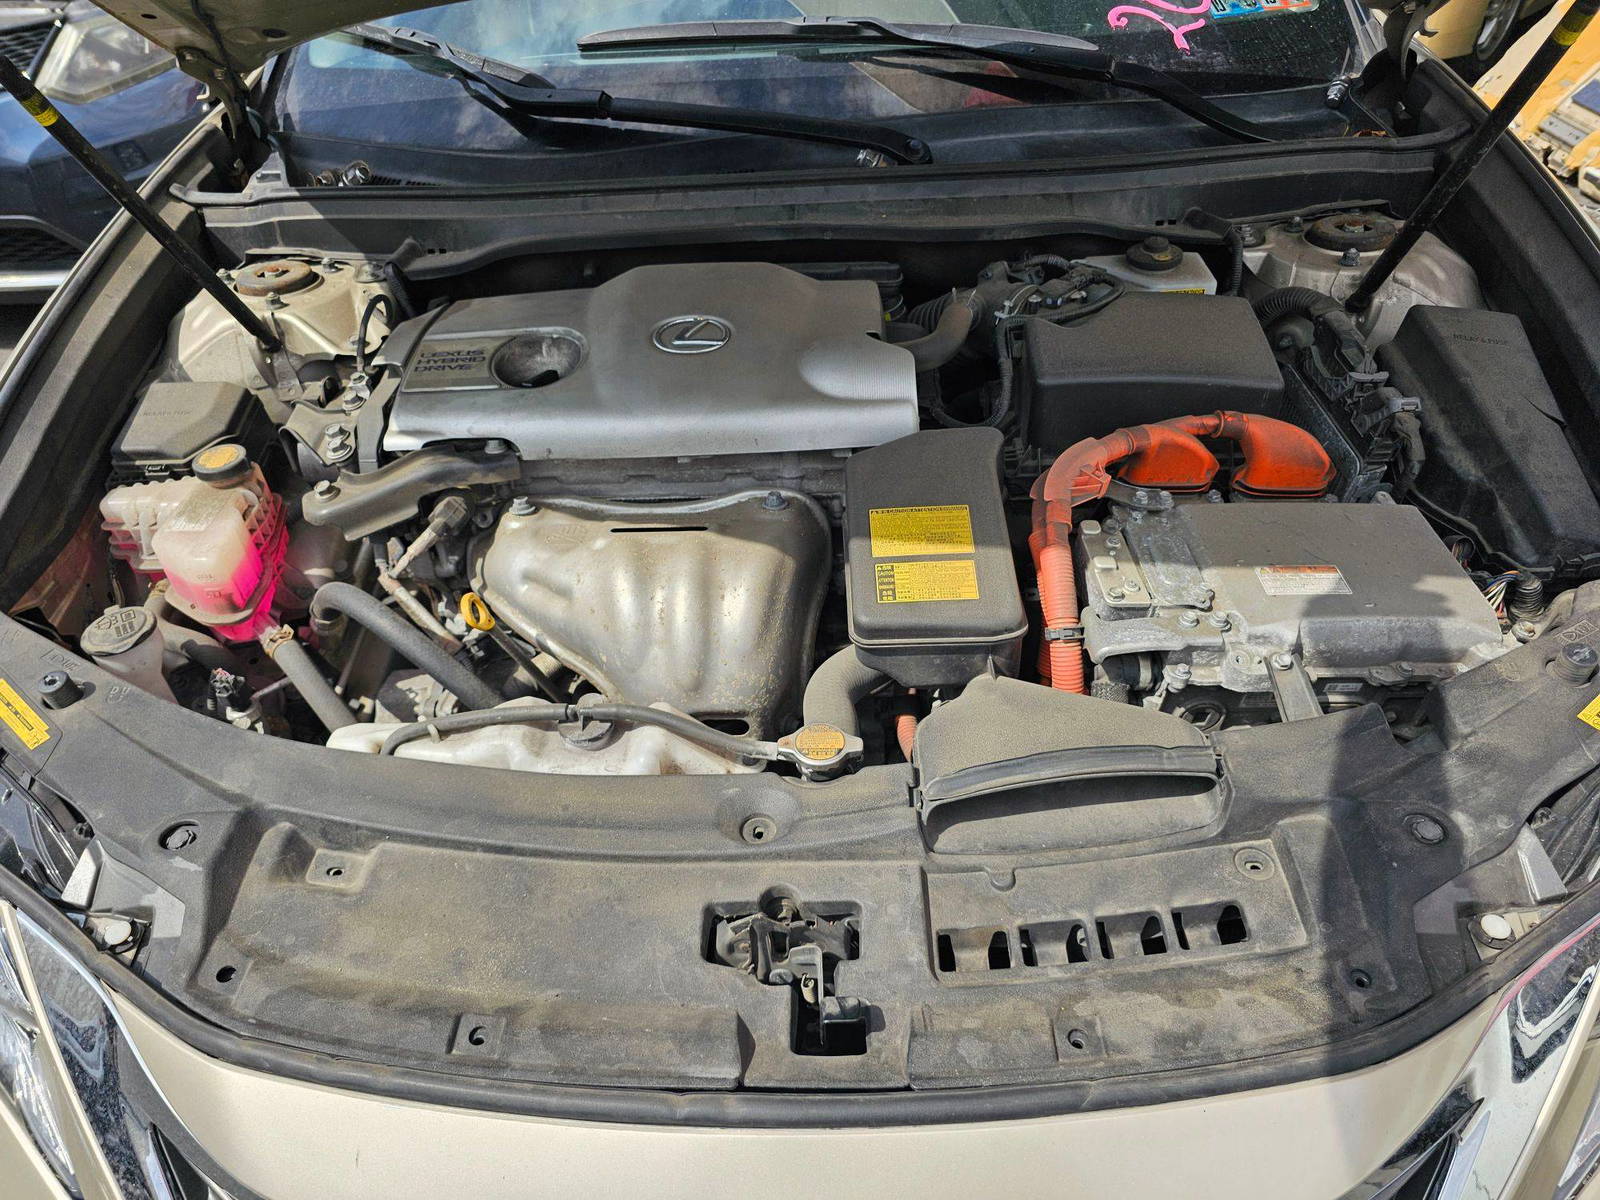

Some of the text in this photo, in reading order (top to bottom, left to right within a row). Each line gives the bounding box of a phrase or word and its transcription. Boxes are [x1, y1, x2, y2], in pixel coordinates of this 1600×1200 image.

[420, 350, 485, 358] LEXUS
[417, 357, 486, 365] HYBRID
[414, 364, 472, 372] DRIVE
